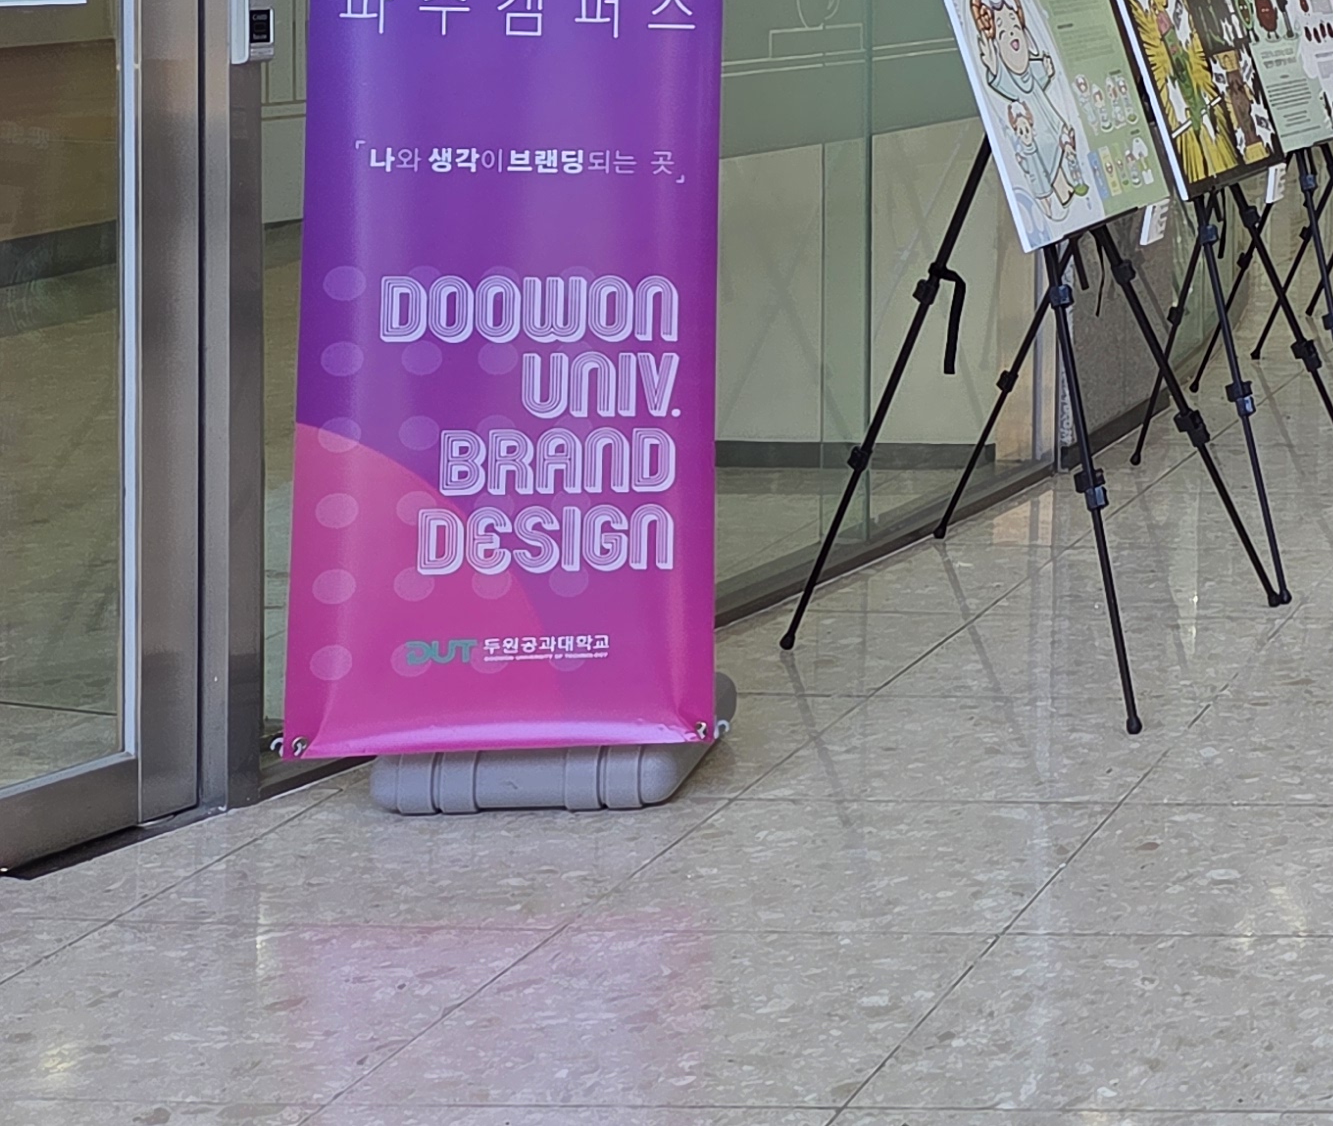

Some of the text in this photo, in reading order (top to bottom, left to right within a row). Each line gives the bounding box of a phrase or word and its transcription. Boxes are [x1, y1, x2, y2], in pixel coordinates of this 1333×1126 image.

[428, 147, 503, 173] 생각이
[507, 149, 637, 174] 브랜딩되는
[380, 275, 679, 343] DOOWON
[520, 351, 682, 419] UNIV.
[440, 427, 677, 497] BRAND
[417, 503, 675, 575] DESIGN
[406, 639, 477, 665] DUT
[483, 635, 610, 655] 두원공과대학교
